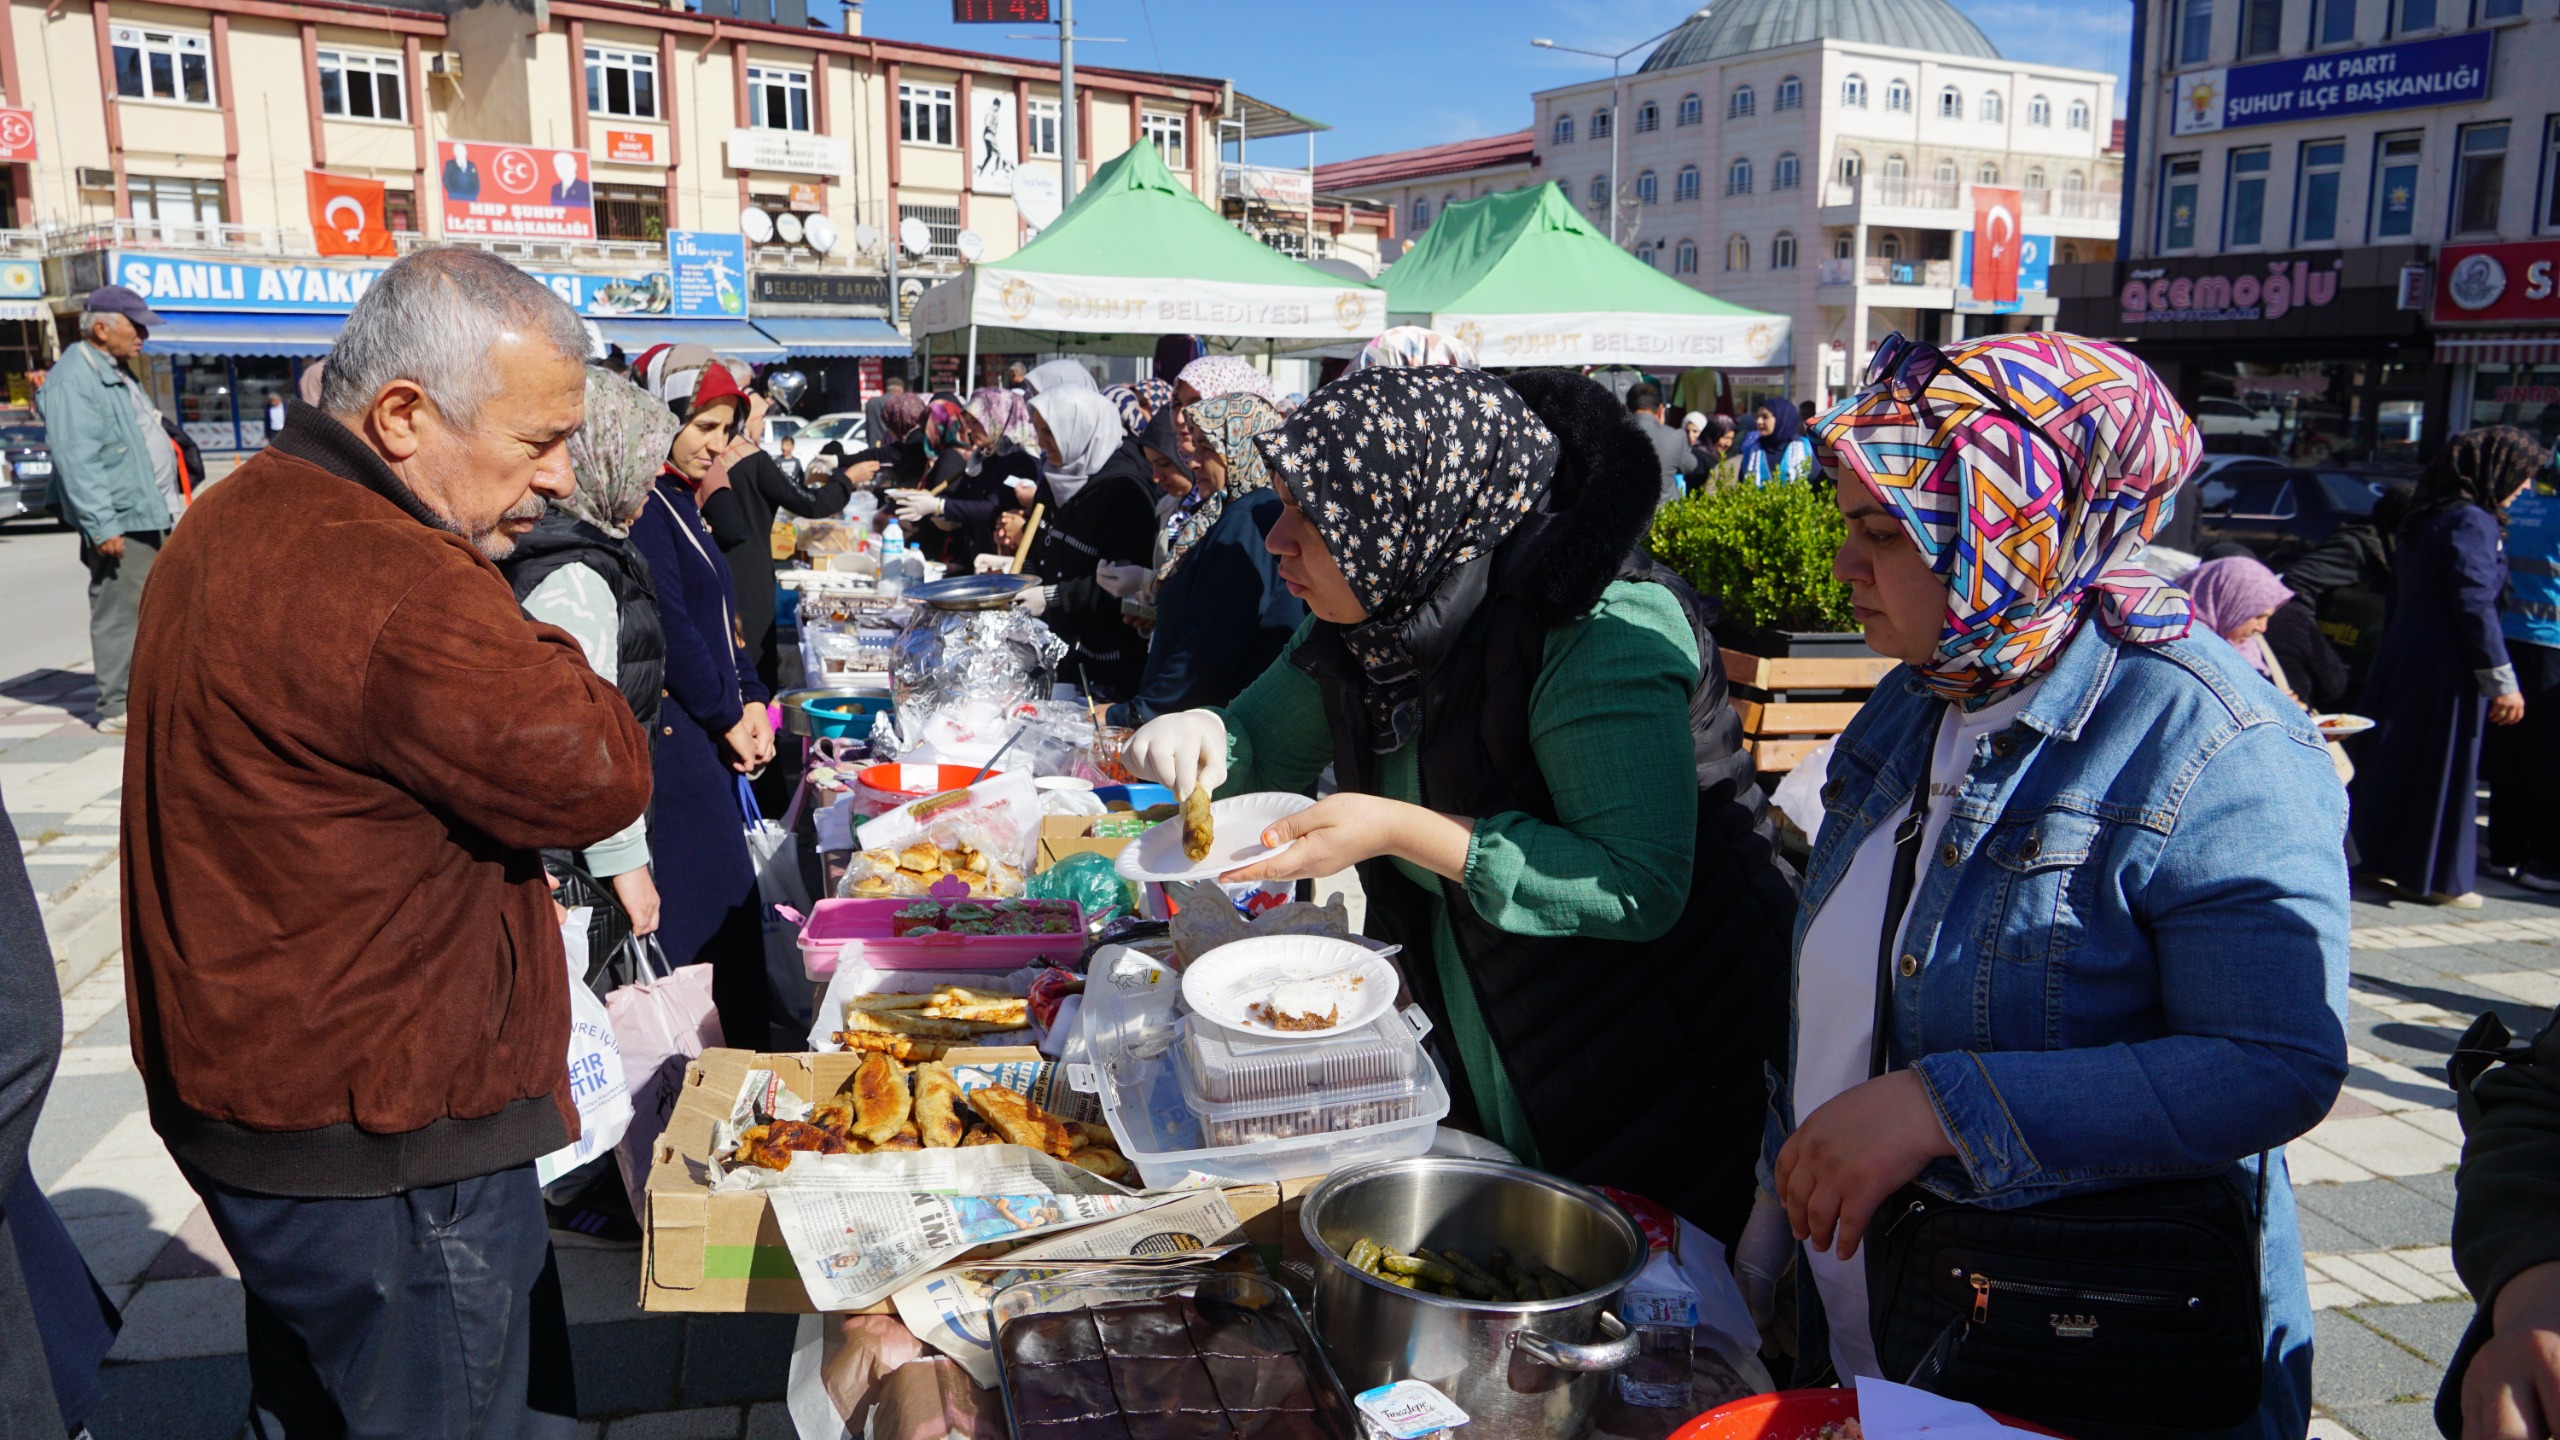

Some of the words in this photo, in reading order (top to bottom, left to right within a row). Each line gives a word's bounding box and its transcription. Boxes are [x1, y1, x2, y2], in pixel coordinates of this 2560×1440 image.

[2302, 62, 2333, 83] AK
[2228, 92, 2293, 121] ŞUHUT
[2345, 64, 2479, 104] BAŞKANLIĞI
[469, 201, 507, 217] MHP
[511, 204, 566, 220] ŞUHUT
[447, 214, 487, 234] İLÇE
[491, 219, 589, 237] BAŞKANLIĞI
[258, 267, 384, 304] AYAKK
[1057, 296, 1148, 320] ŞUHUT
[1503, 333, 1582, 354] ŞUHUT
[2050, 1314, 2099, 1328] ZARA
